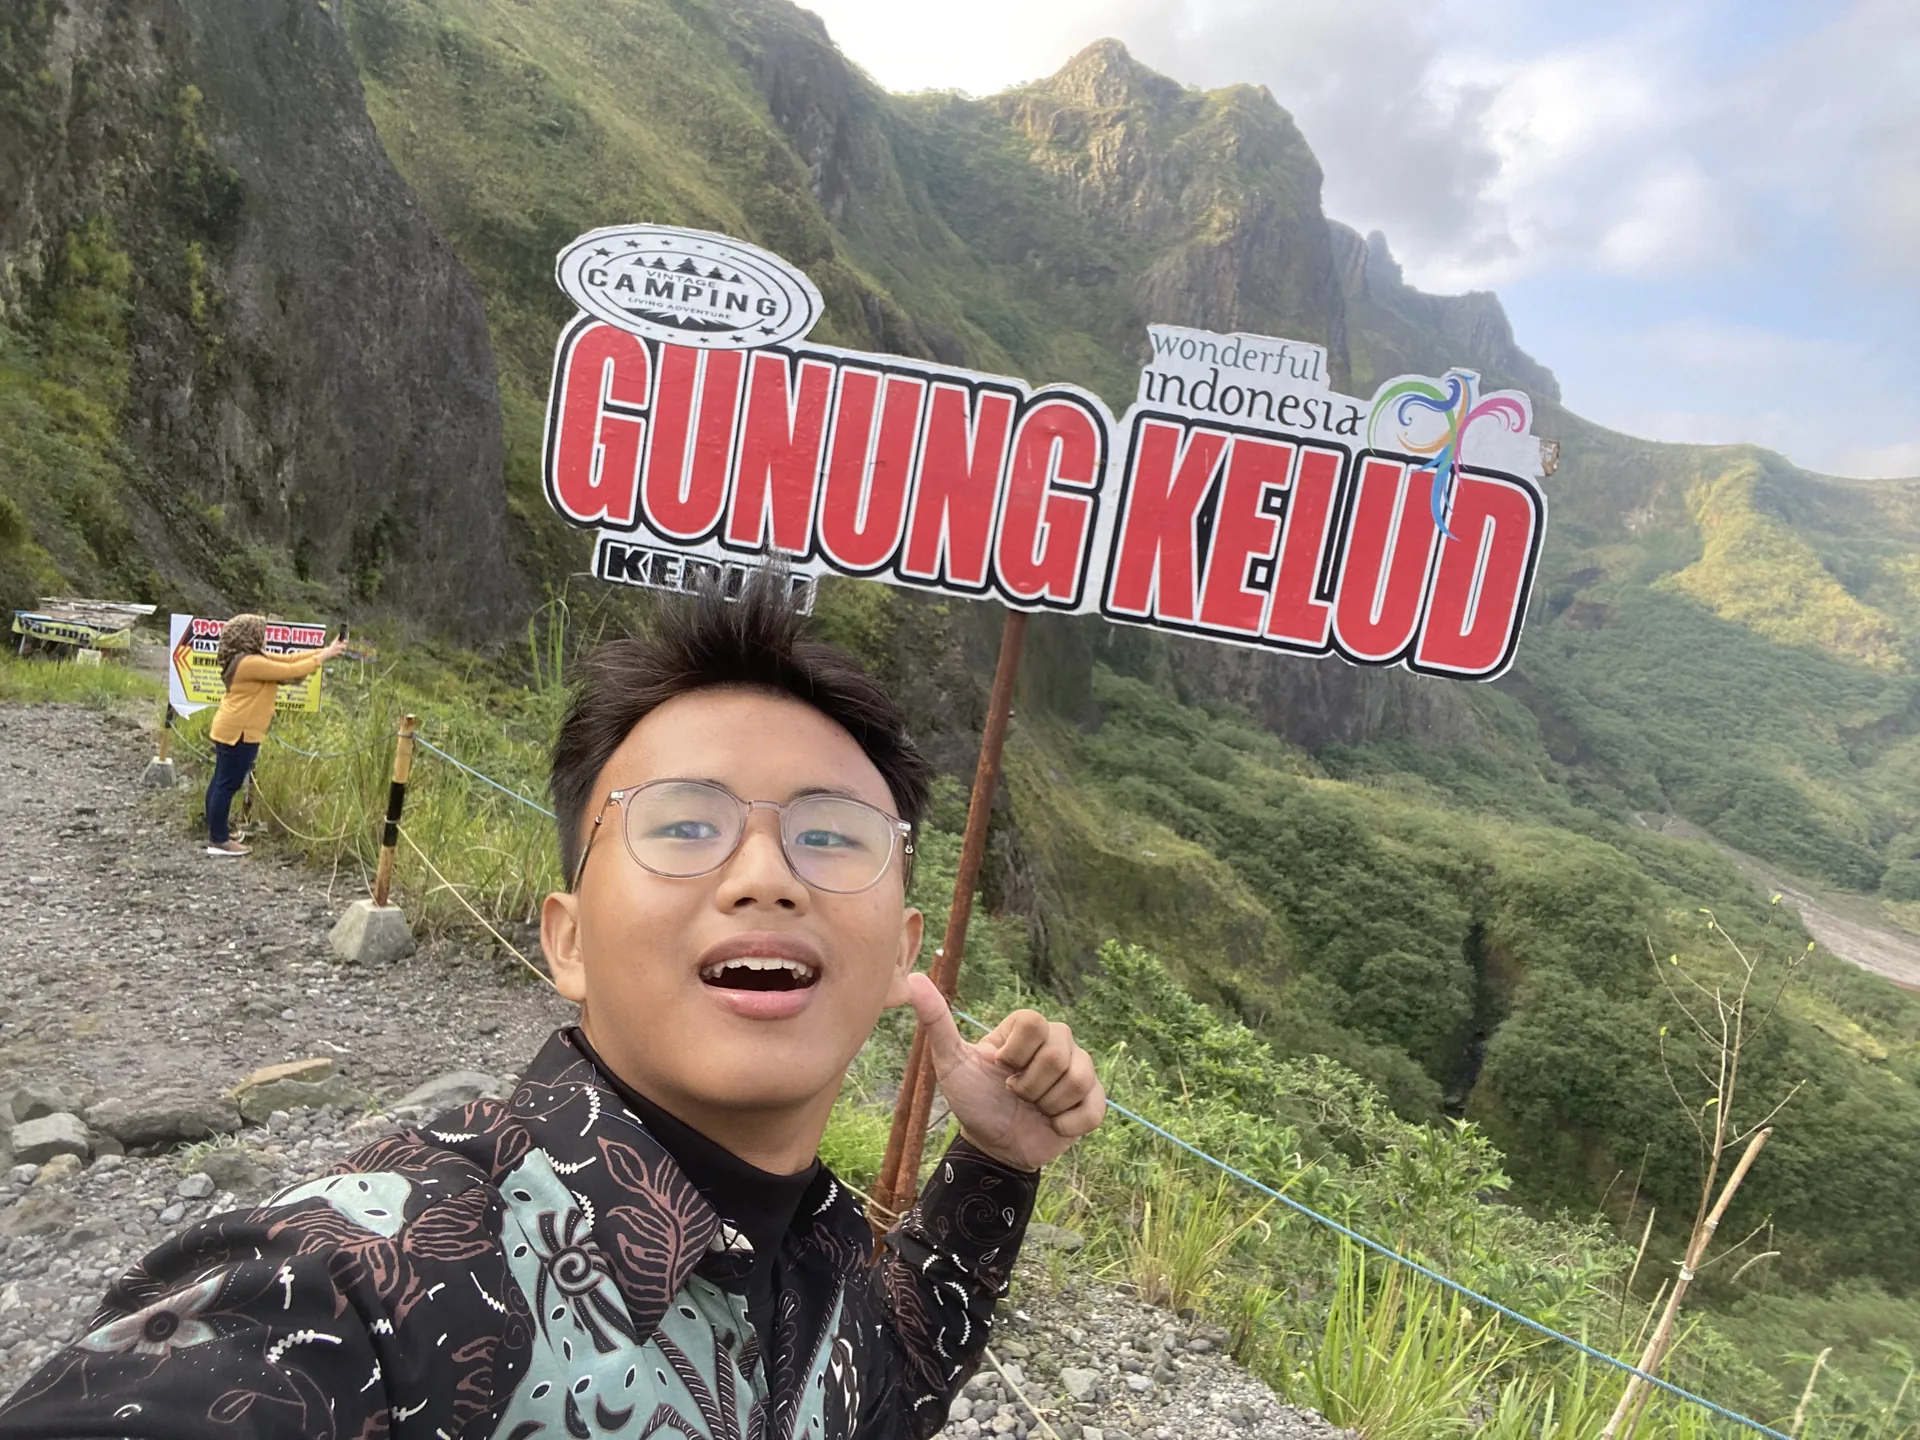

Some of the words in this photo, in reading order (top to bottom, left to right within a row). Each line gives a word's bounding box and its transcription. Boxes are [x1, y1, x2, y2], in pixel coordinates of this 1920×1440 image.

[588, 268, 777, 317] CAMPING
[646, 270, 717, 288] VINTAGE
[628, 297, 664, 308] LIVING
[667, 303, 732, 320] ADVENTURE
[1151, 332, 1321, 382] wonderful
[1145, 369, 1367, 436] indonesia
[552, 322, 1100, 601] GUNUNG
[1110, 419, 1539, 673] KELUD
[291, 628, 325, 646] HITZ
